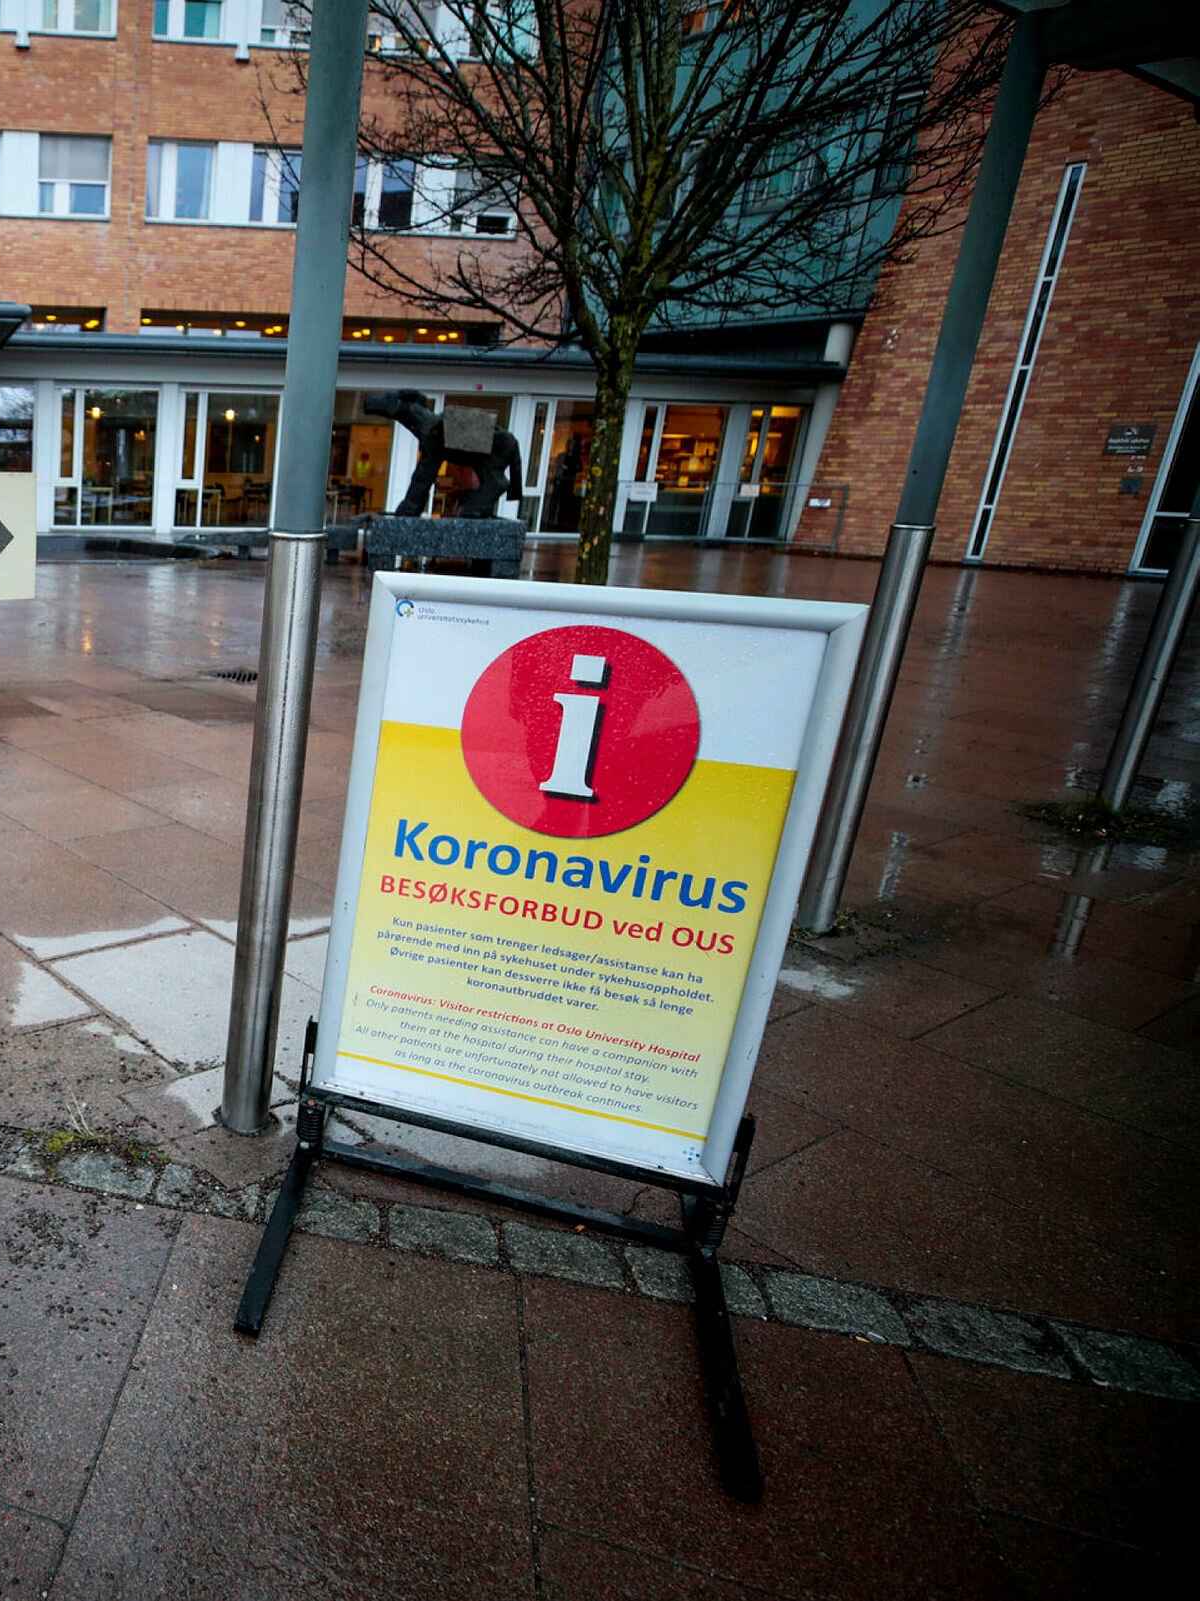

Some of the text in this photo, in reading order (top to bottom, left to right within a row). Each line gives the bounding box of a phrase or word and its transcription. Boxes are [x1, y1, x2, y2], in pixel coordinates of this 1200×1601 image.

[393, 818, 750, 914] Koronavirus
[379, 874, 735, 955] BESØKSFORBUD ved OUS
[392, 916, 704, 984] Kun pasienter som trenger ledsager/assistanse kan ha
[376, 929, 715, 1003] pårørende med inn på sykehuset under sykehusoppholdet.
[390, 946, 694, 1016] Øvrige pasienter kan dessverre ikke få besøk så lenge
[466, 976, 599, 1012] koronautbruddet varer.
[366, 998, 699, 1079] Only patients needing assistance can have a companion with
[370, 984, 702, 1063] Coronavirus: Visitor restrictions at Oslo University Hospital
[400, 1021, 650, 1084] them at the hospital during their hospital stay.
[355, 1025, 699, 1111] All other patients are unfortunately not allowed to have visitors
[394, 1049, 644, 1113] as long as the coronavirus outbreak continues.
